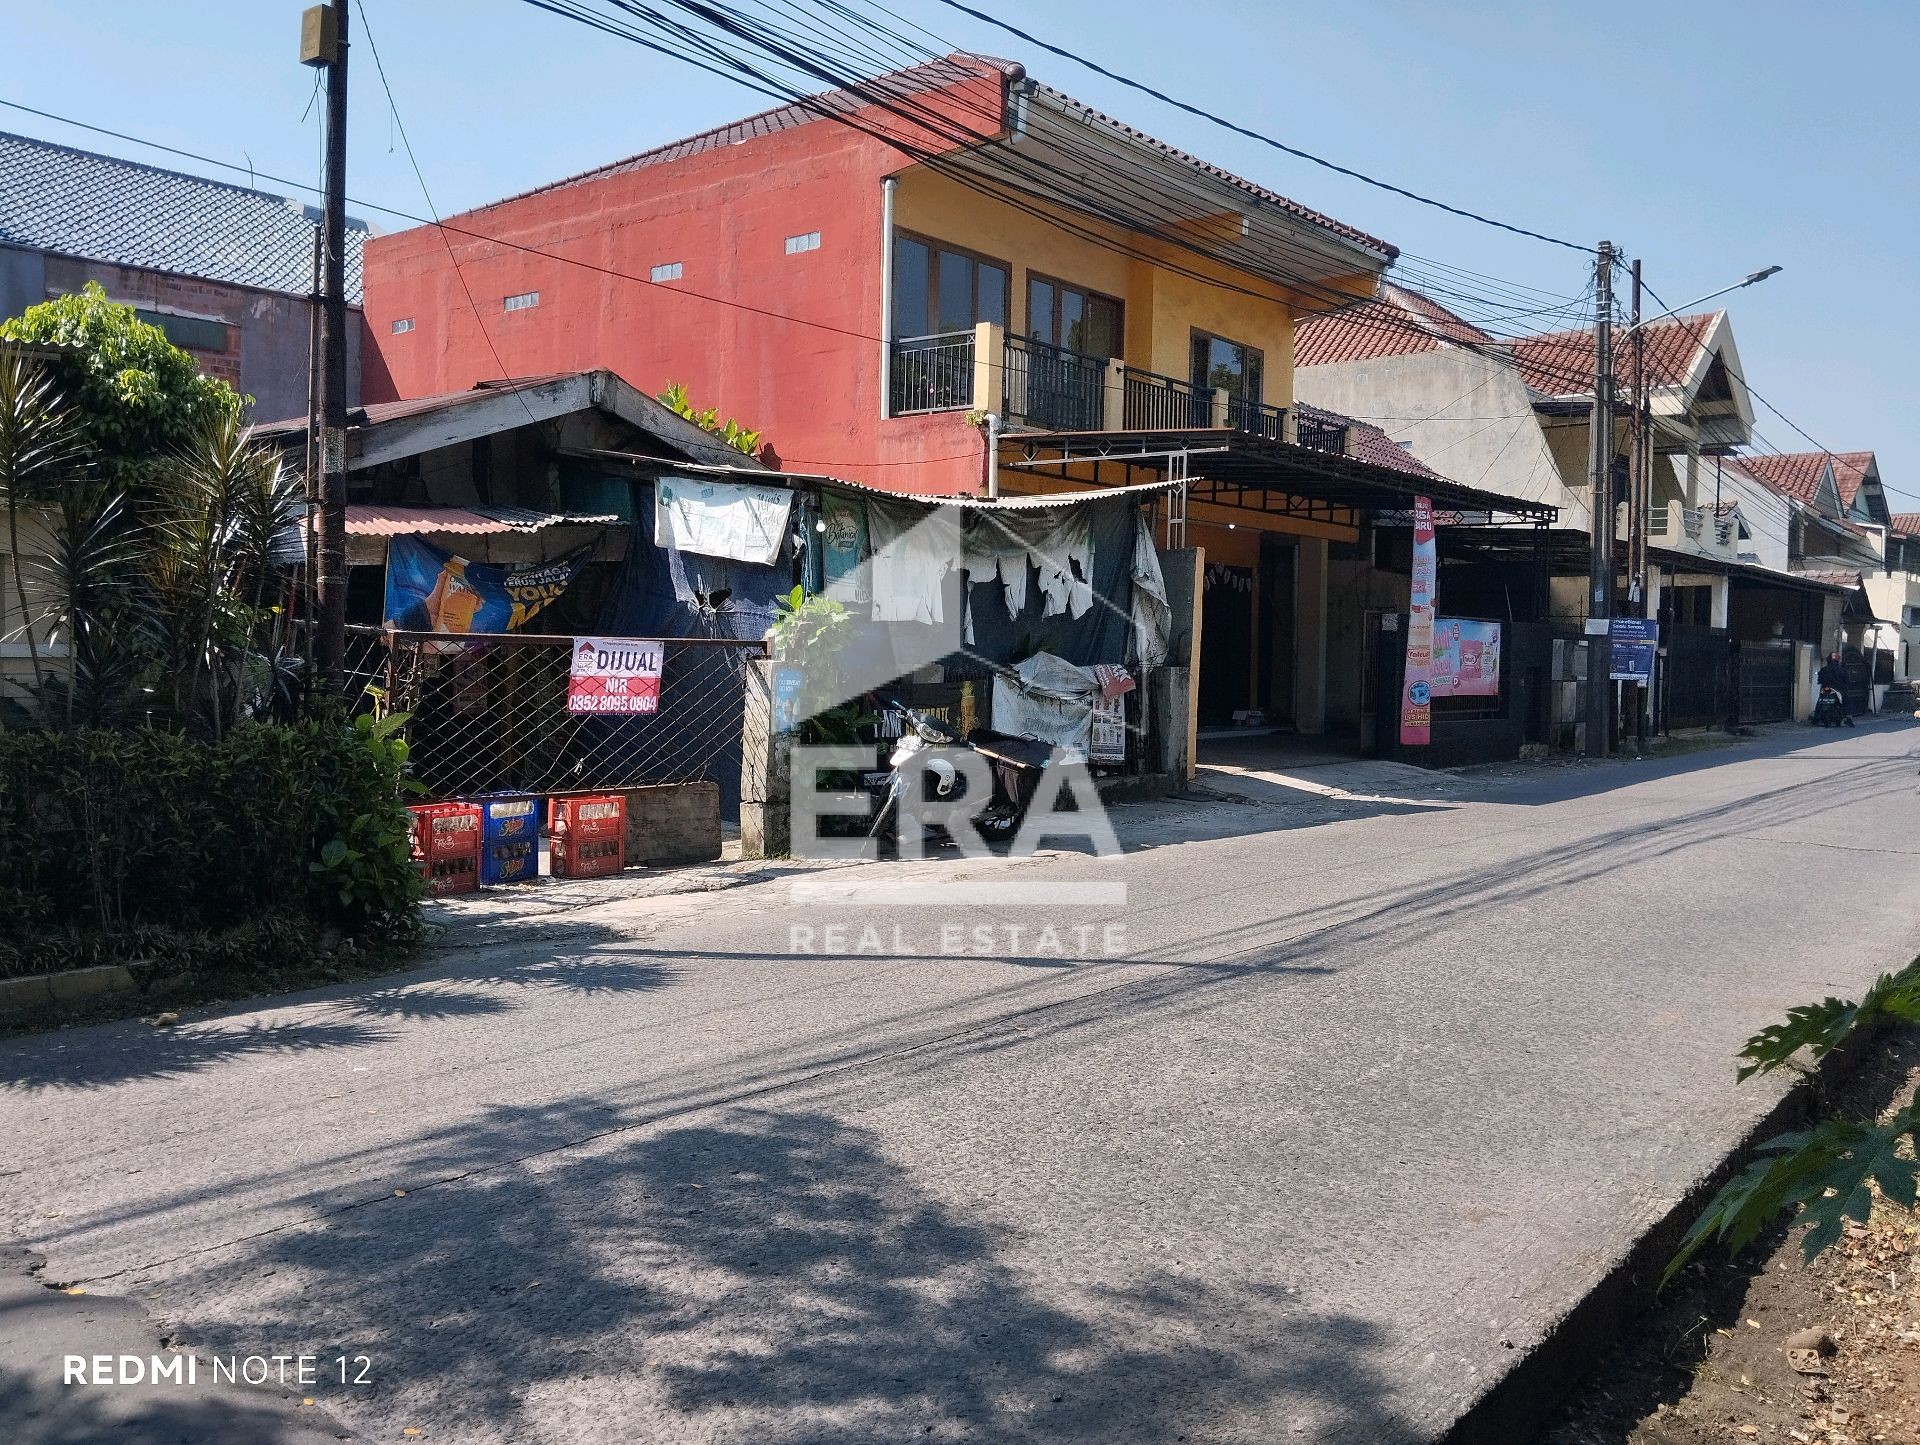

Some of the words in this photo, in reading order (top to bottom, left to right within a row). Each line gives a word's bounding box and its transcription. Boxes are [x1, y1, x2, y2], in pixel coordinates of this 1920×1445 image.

[578, 653, 594, 661] ERA
[597, 649, 657, 672] DIJUAL
[605, 677, 628, 693] NIR
[629, 695, 657, 711] 0804
